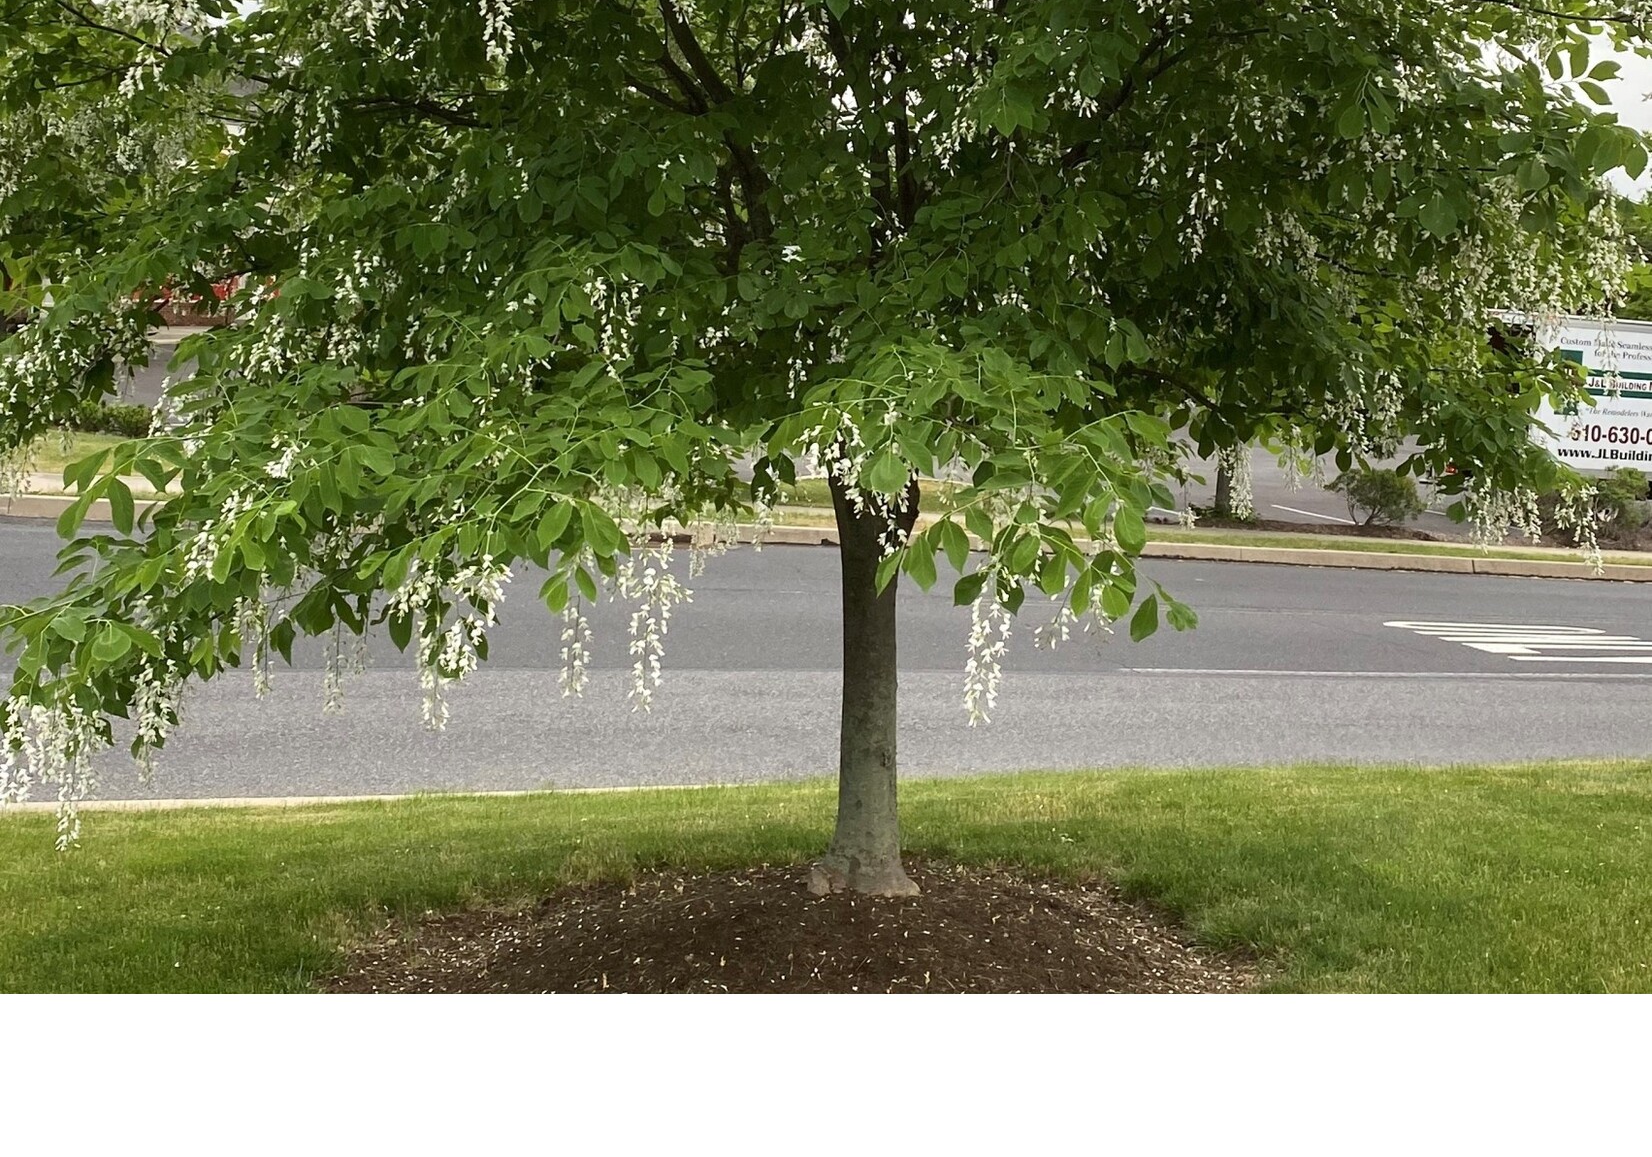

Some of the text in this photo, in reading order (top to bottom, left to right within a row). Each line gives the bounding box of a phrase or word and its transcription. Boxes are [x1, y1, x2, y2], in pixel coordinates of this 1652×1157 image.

[1560, 336, 1592, 347] Custom
[1588, 377, 1607, 389] J&L
[1602, 407, 1639, 417] Remodelers
